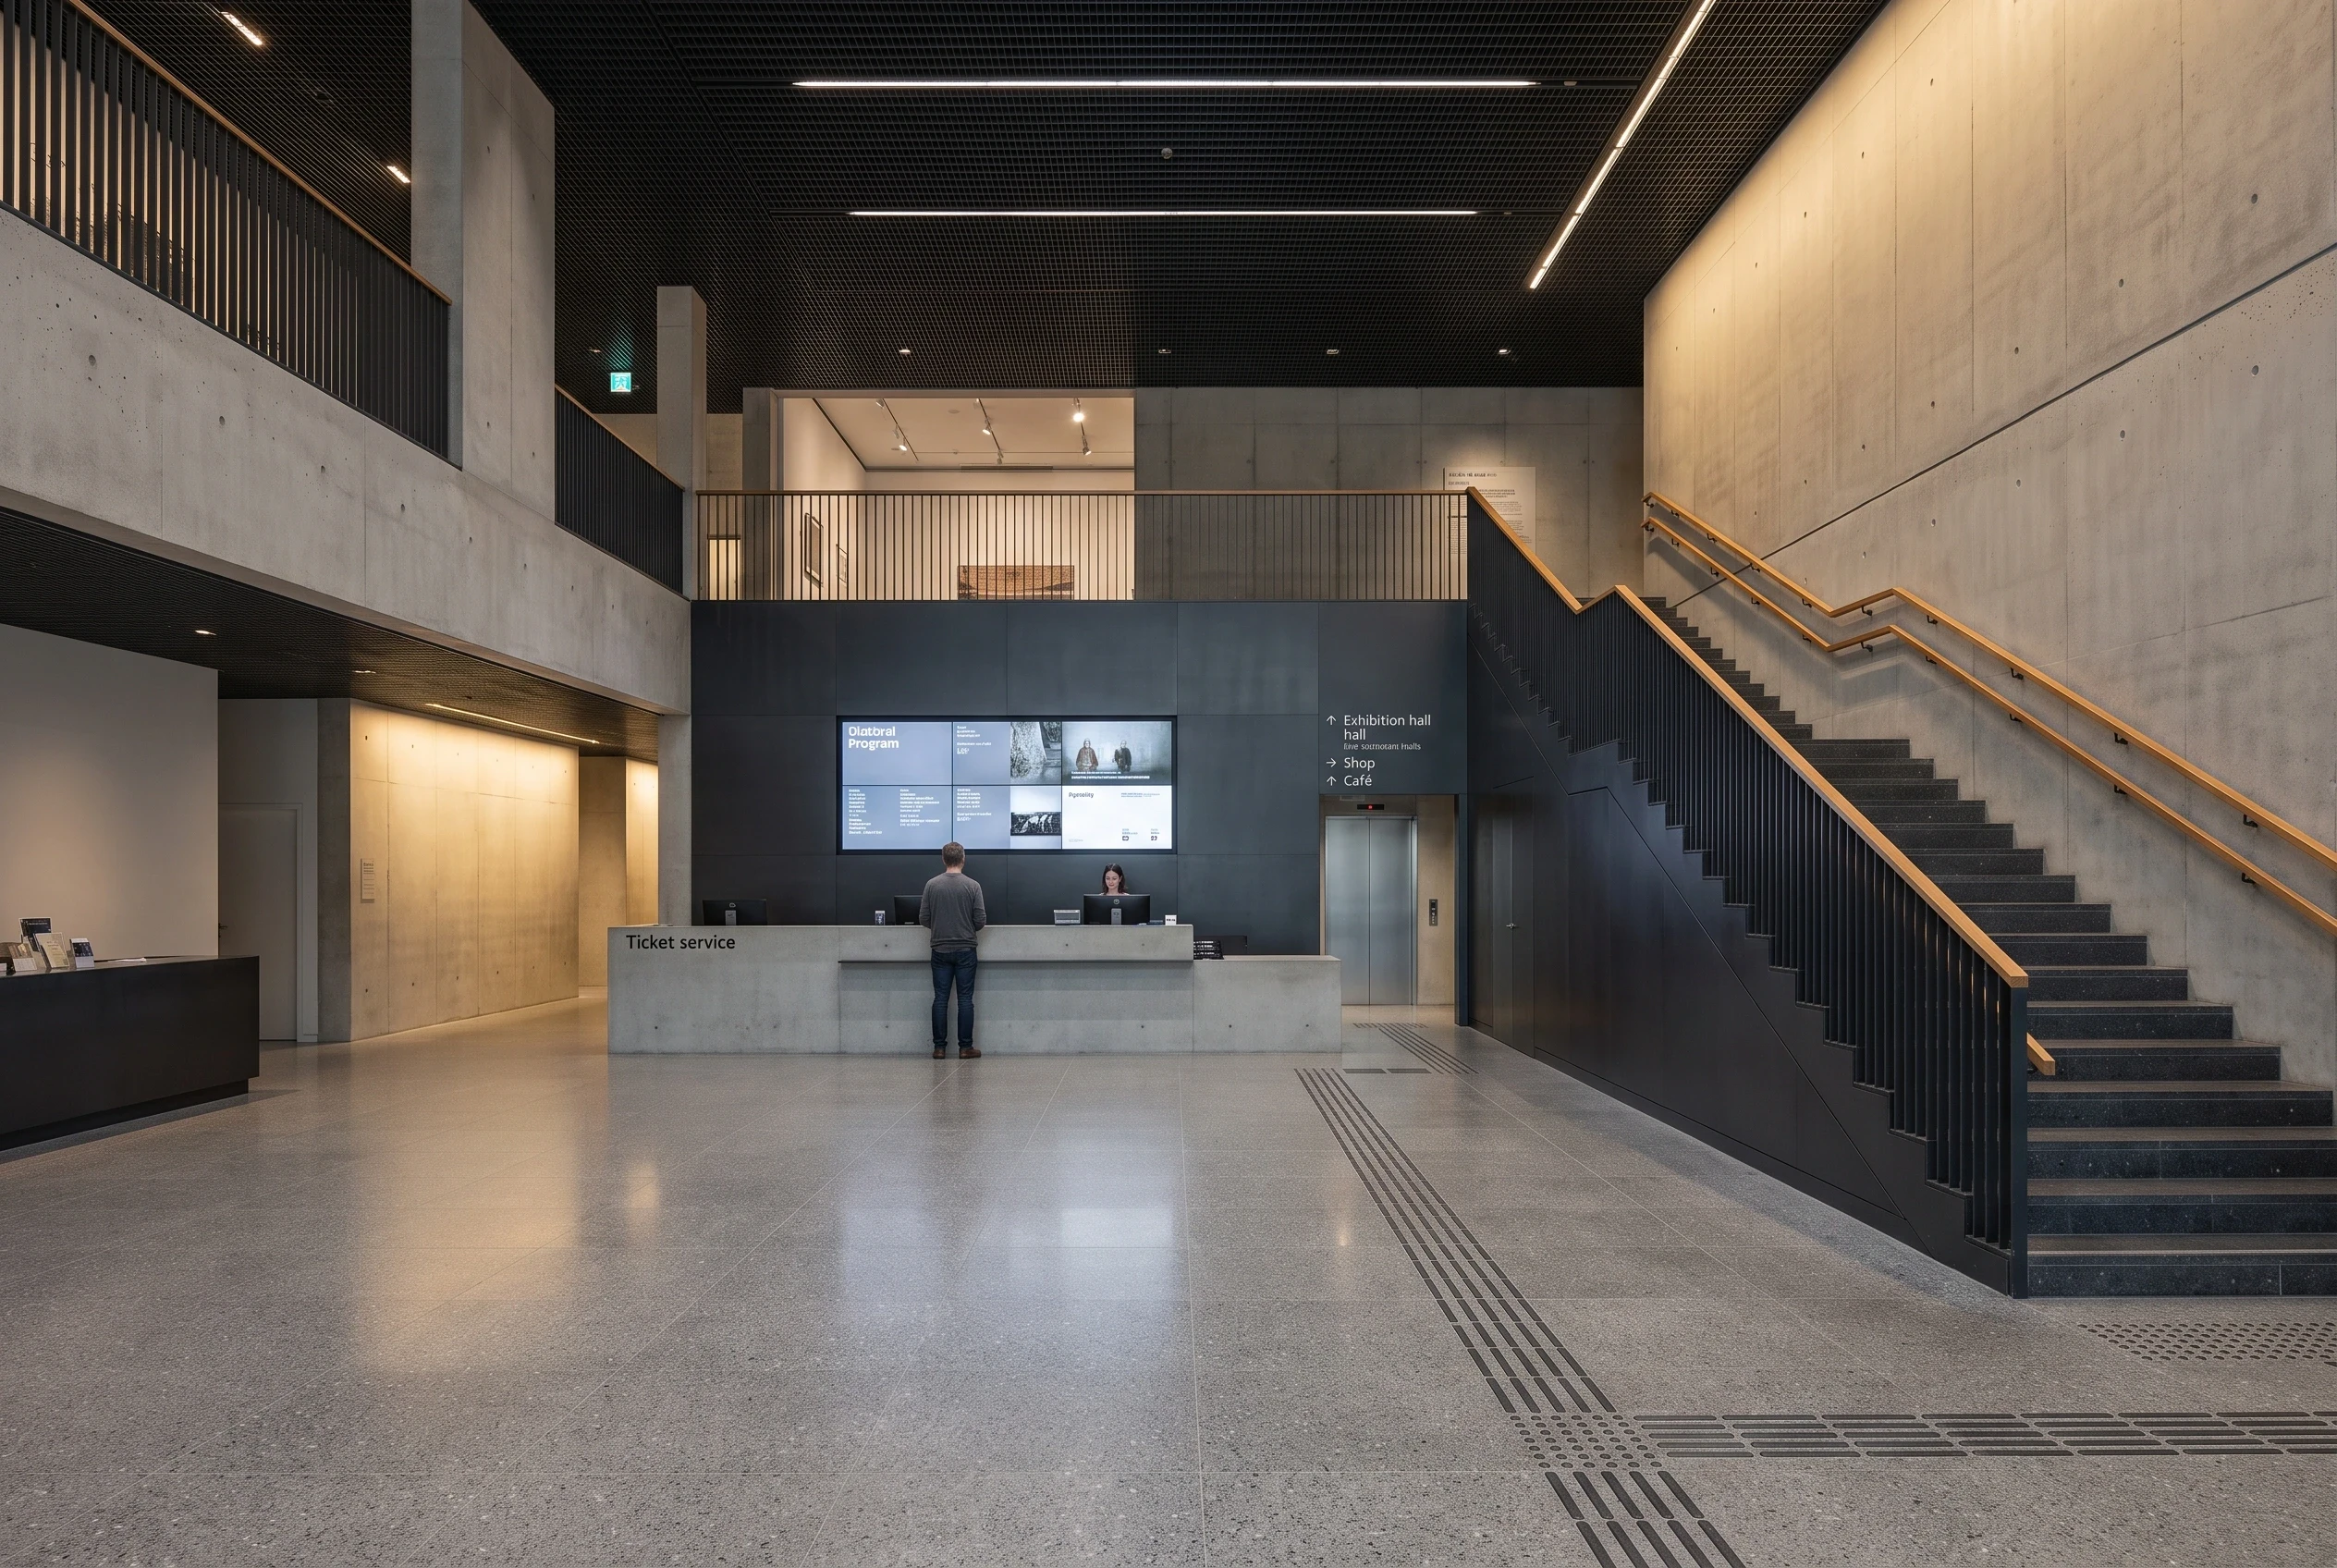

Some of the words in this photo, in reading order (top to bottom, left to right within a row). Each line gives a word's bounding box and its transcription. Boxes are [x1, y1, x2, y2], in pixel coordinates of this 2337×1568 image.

[1344, 714, 1405, 726] Exhibition
[1409, 714, 1431, 726] hall
[1344, 729, 1366, 741] hall
[848, 738, 899, 751] Program
[1344, 756, 1376, 771] Shop
[1344, 775, 1373, 787] Café
[626, 935, 675, 949] Ticket
[679, 935, 736, 949] service
